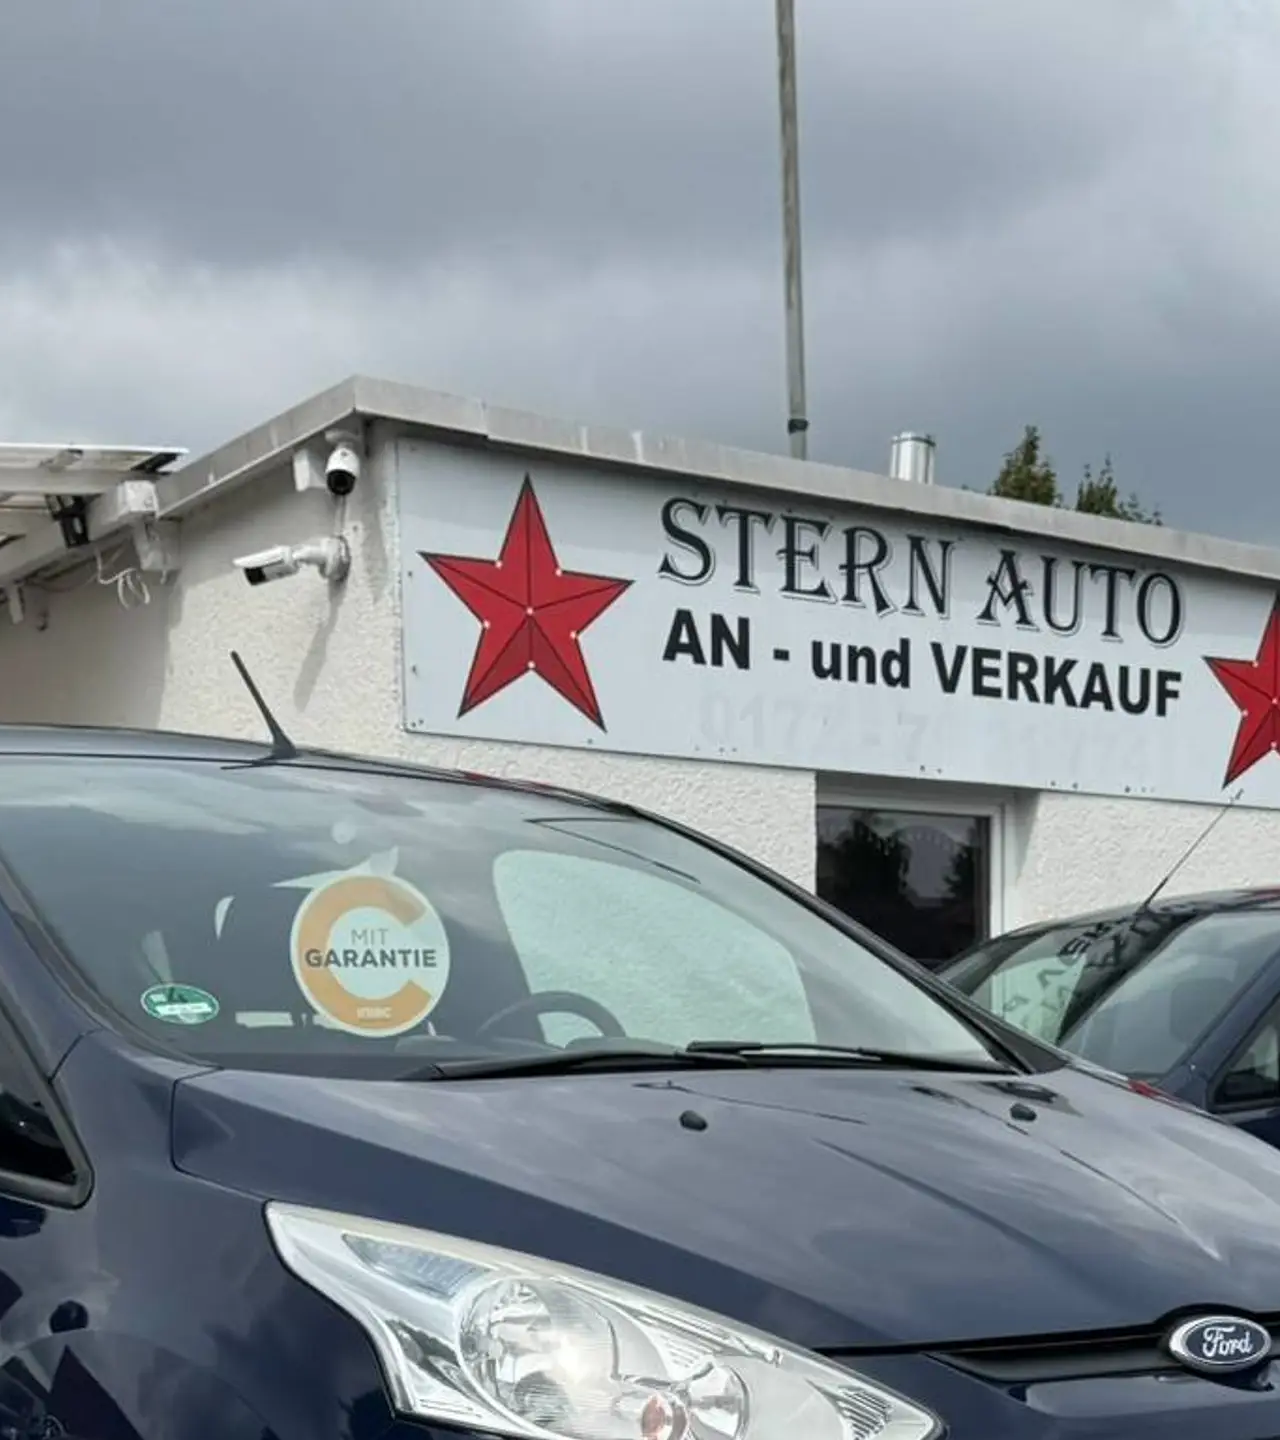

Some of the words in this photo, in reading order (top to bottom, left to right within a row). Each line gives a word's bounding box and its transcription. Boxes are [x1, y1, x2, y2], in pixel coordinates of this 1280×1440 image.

[658, 497, 953, 617] STERN
[977, 549, 1186, 649] AUTO
[662, 607, 751, 671] AN
[811, 638, 912, 690] und
[930, 641, 1183, 718] VERKAUF
[351, 928, 389, 946] MIT
[305, 947, 437, 968] GARANTIE
[1202, 1324, 1254, 1358] Ford
